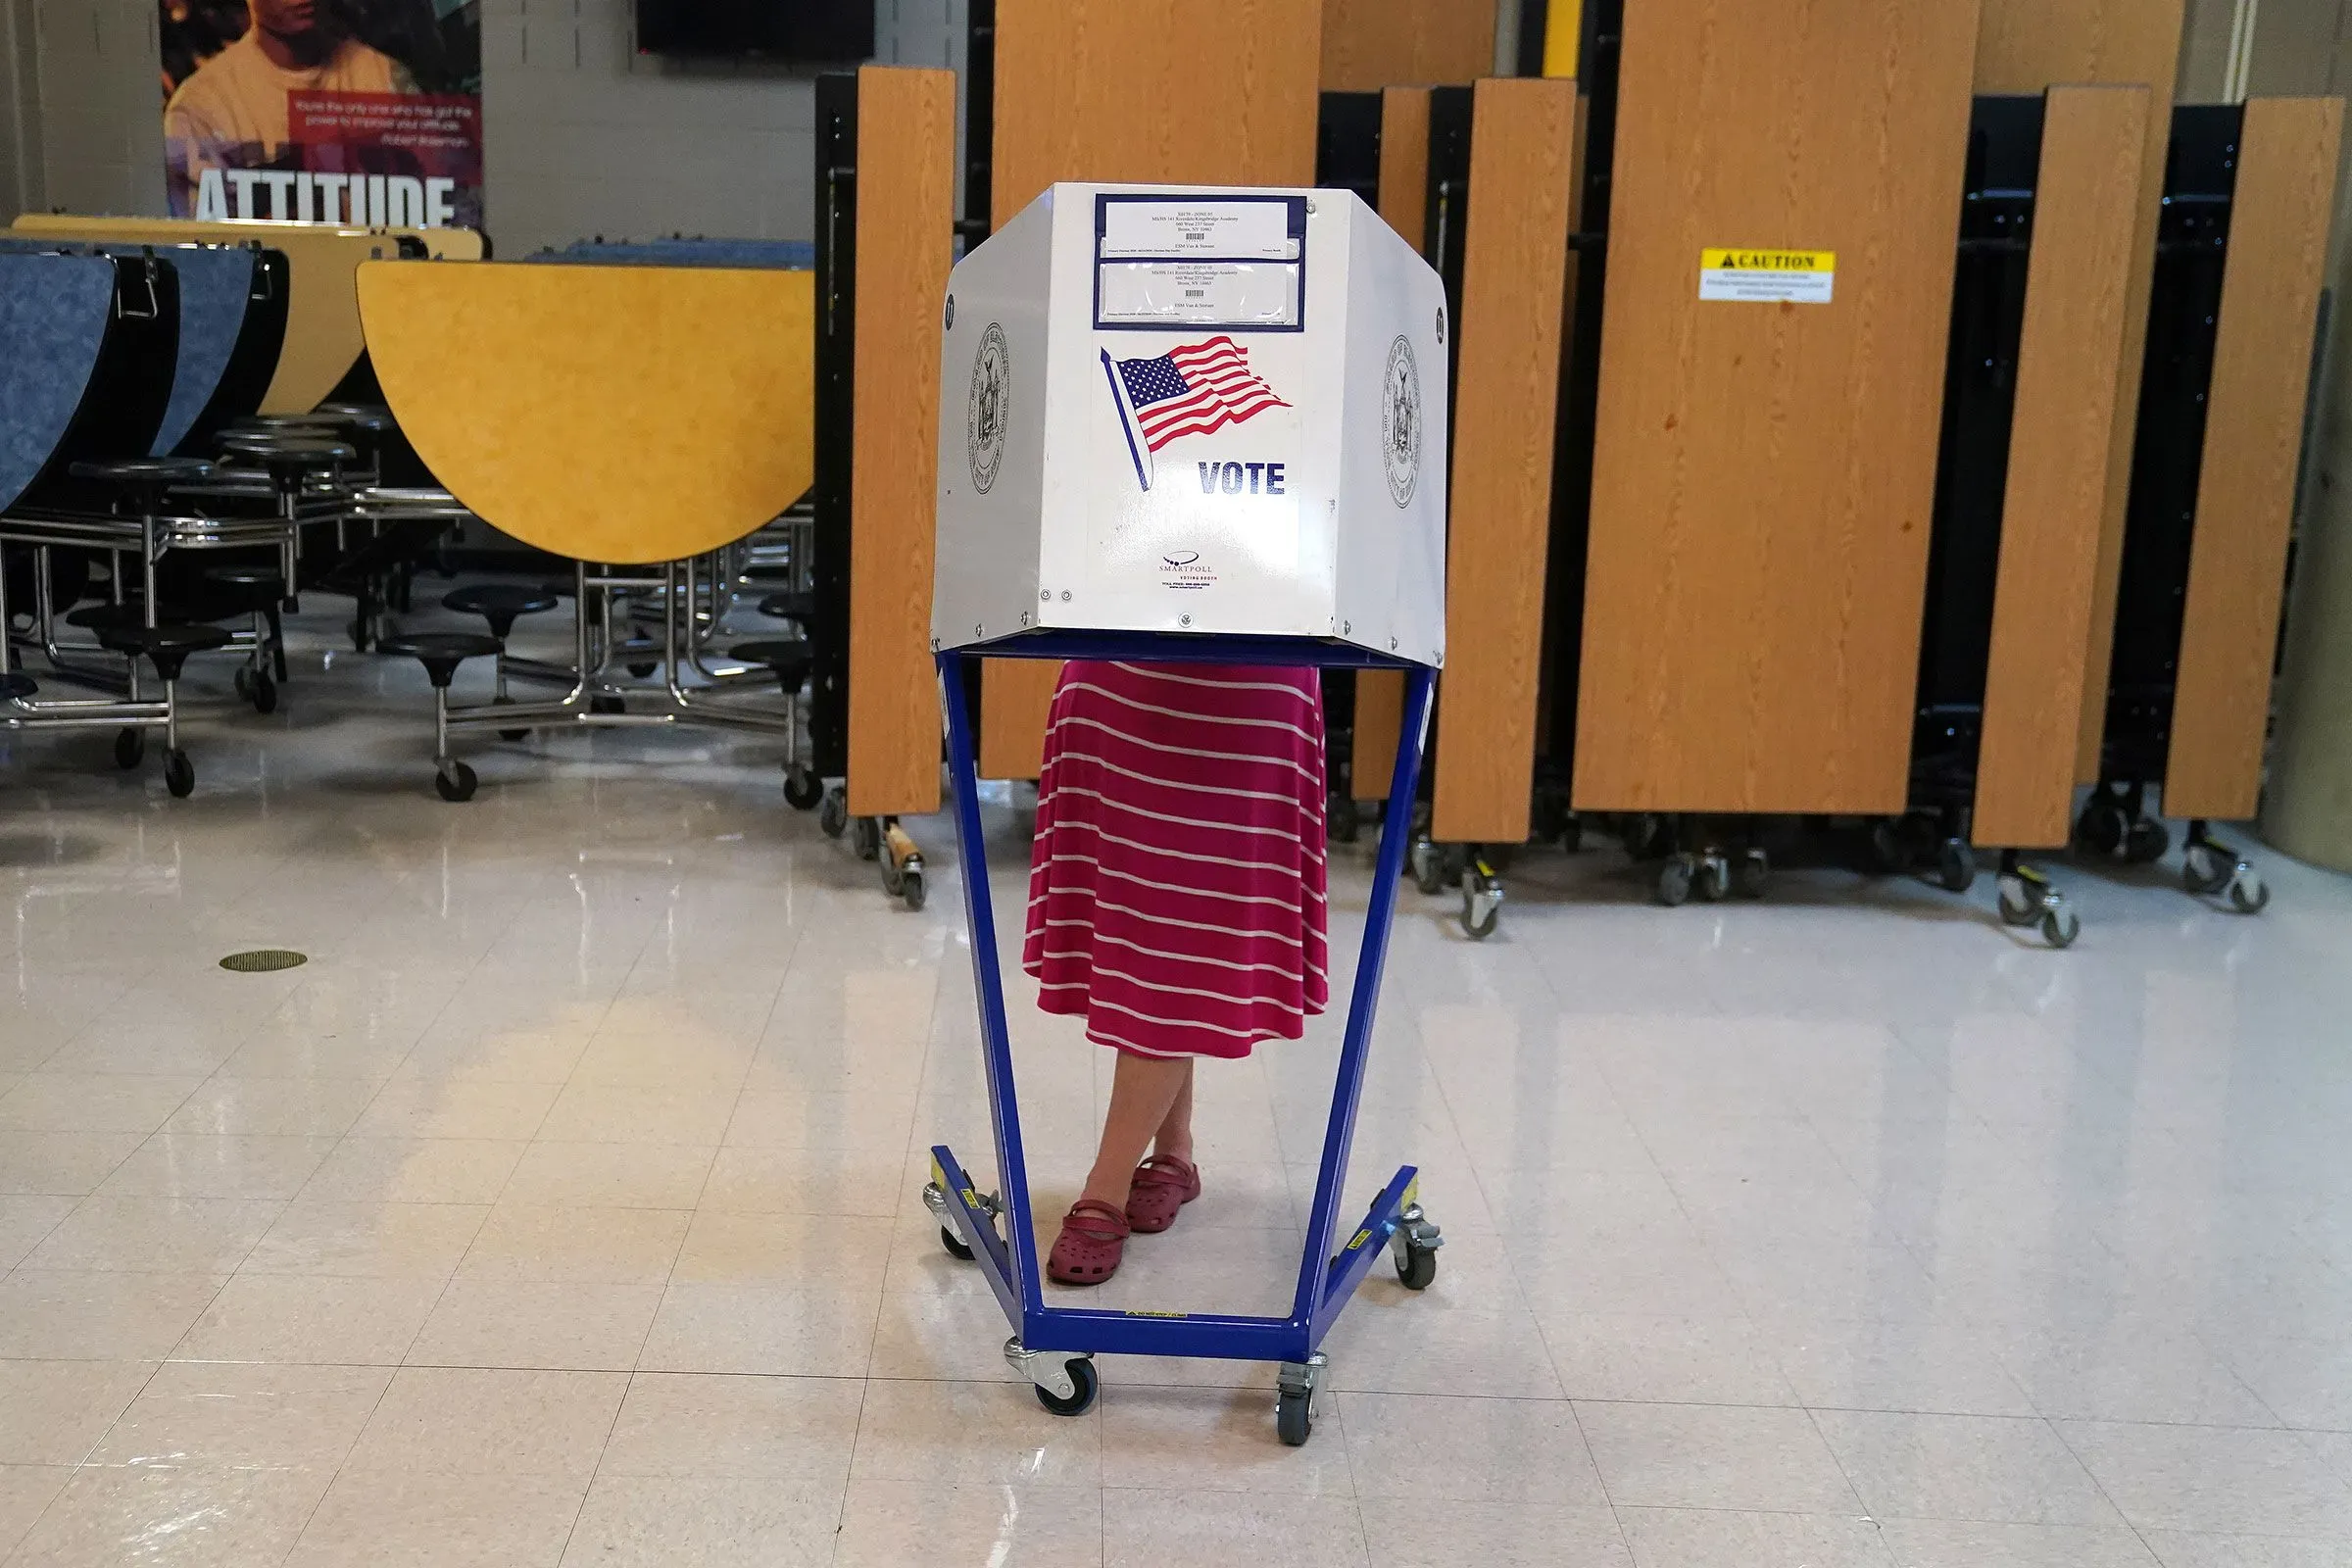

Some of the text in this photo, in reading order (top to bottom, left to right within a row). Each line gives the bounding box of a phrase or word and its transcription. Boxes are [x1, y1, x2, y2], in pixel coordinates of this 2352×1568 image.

[196, 168, 455, 227] ATTITUDE
[1739, 255, 1815, 269] CAUTION
[1198, 462, 1285, 494] VOTE
